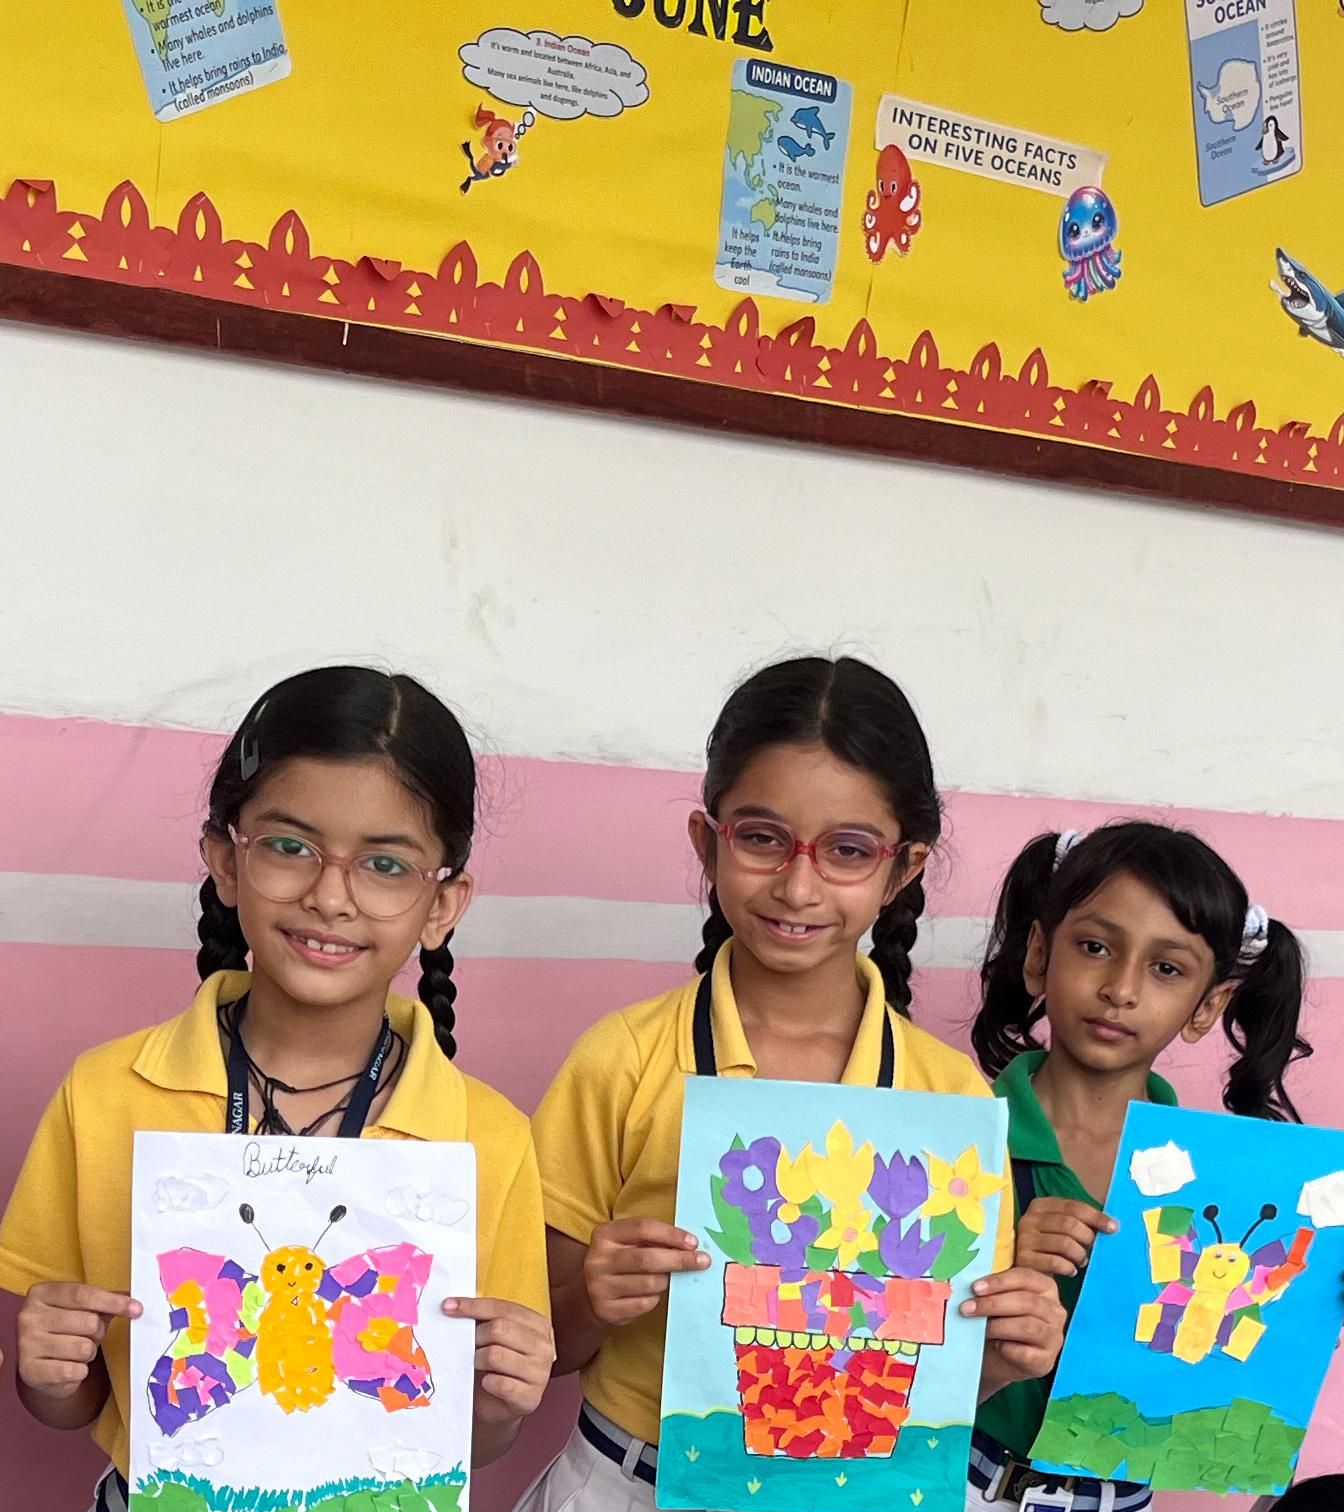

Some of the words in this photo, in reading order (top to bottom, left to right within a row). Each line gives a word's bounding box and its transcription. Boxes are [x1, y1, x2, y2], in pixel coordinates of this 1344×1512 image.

[152, 7, 193, 32] warmest
[194, 1, 222, 17] ocean
[1214, 0, 1267, 24] OCEAN
[158, 37, 184, 56] Many
[185, 24, 217, 44] whales
[218, 15, 235, 33] and
[237, 5, 274, 27] dolphins
[612, 0, 774, 52] NE
[544, 38, 566, 51] Indian
[567, 44, 590, 57] Ocean
[162, 57, 181, 73] live
[168, 80, 177, 95] It
[176, 73, 204, 92] helps
[205, 62, 227, 80] bring
[228, 55, 251, 71] rains
[252, 51, 262, 65] to
[174, 89, 205, 112] (called
[206, 71, 254, 99] monsoons)
[751, 64, 791, 88] INDIAN
[793, 74, 833, 97] OCEAN
[1223, 100, 1245, 113] Ocean
[892, 106, 1018, 154] INTERESTING
[1024, 141, 1078, 170] FACTS
[908, 133, 937, 154] ON
[944, 142, 984, 166] FIVE
[991, 154, 1063, 187] OCEANS
[778, 161, 785, 173] It
[794, 164, 806, 178] the
[807, 167, 840, 185] warmest
[777, 196, 796, 212] Many
[798, 200, 823, 215] whales
[823, 206, 839, 218] and
[775, 212, 806, 229] dolphins
[807, 218, 820, 230] live
[731, 227, 739, 238] It
[739, 230, 760, 244] helps
[780, 232, 801, 247] helps
[802, 236, 822, 252] bring
[724, 241, 743, 257] keep
[743, 246, 757, 257] the
[770, 247, 790, 260] rains
[791, 250, 799, 261] to
[800, 250, 820, 264] India
[734, 274, 751, 286] cool
[769, 260, 794, 276] (called
[794, 267, 832, 282] monsoons)
